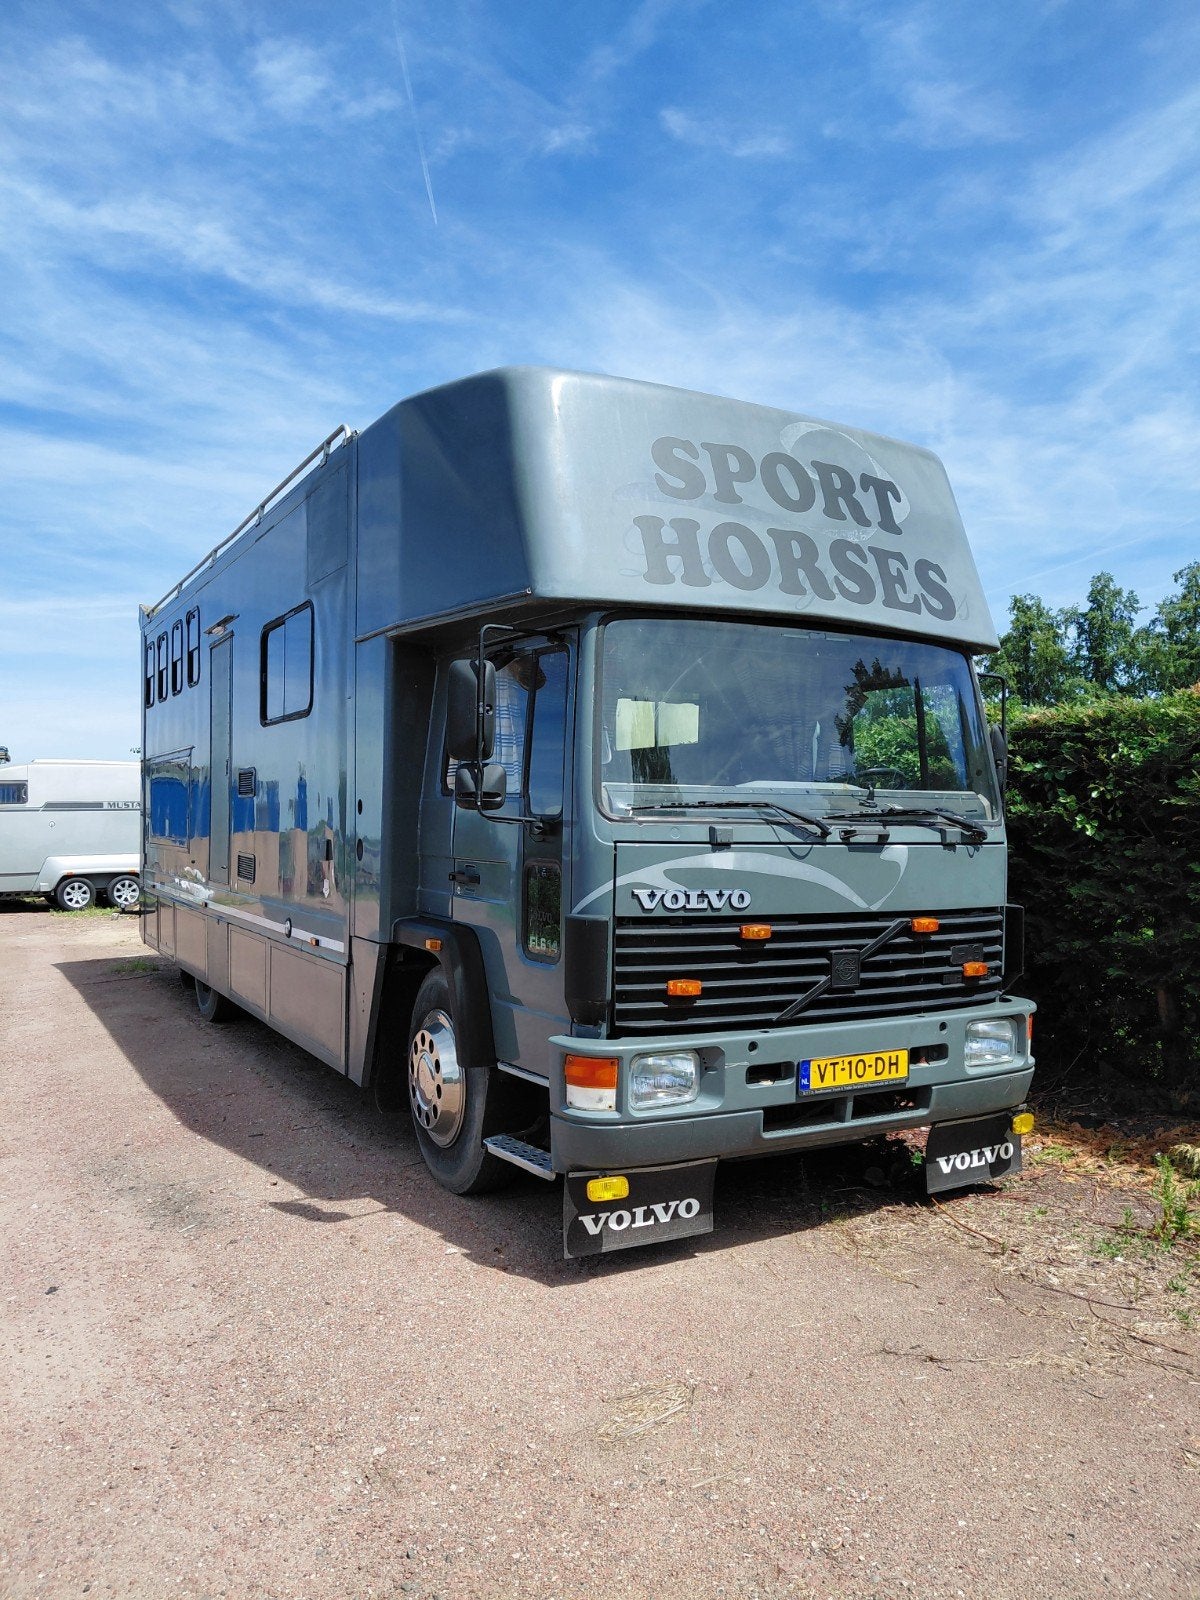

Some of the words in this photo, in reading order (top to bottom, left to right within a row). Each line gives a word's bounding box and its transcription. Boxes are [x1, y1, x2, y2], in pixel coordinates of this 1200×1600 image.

[651, 435, 902, 536] SPORT
[633, 514, 957, 621] HORSES
[632, 888, 752, 912] VOLVO
[801, 1077, 810, 1085] NL
[817, 1054, 900, 1083] VT-10-DH
[937, 1142, 1015, 1174] VOLVO
[578, 1198, 701, 1236] VOLVO
